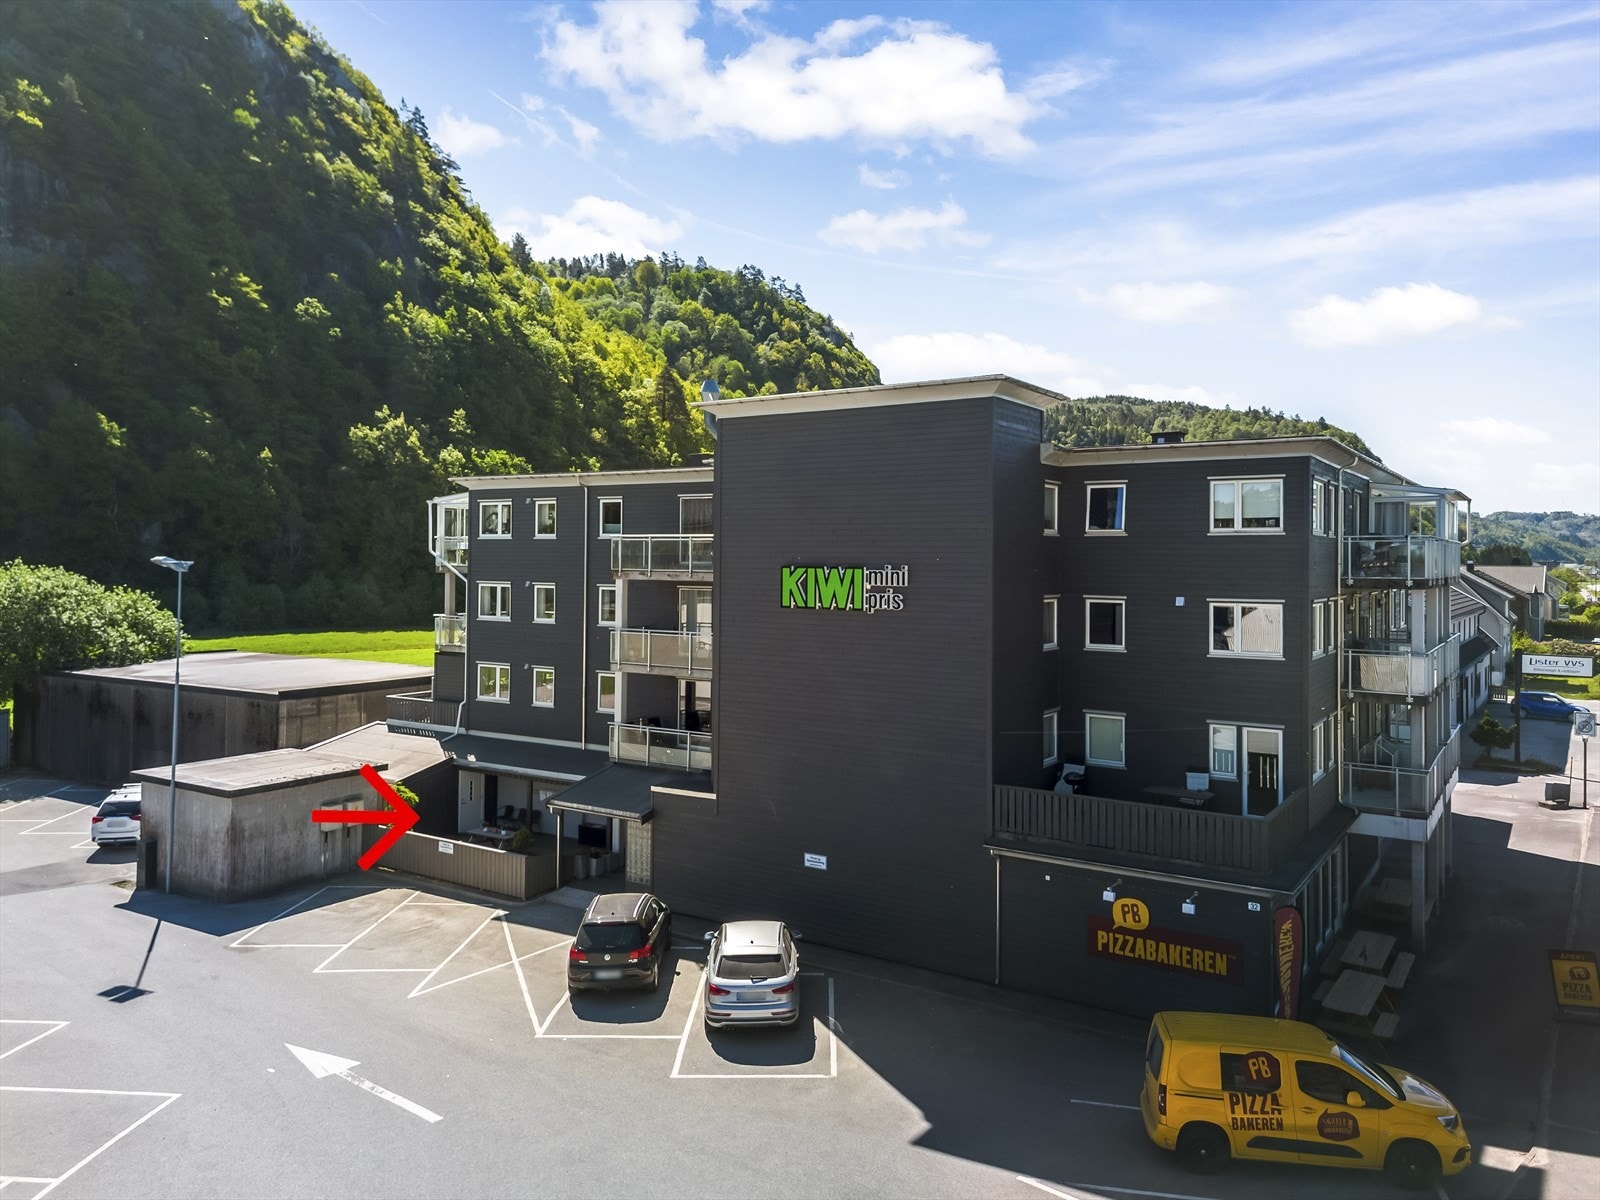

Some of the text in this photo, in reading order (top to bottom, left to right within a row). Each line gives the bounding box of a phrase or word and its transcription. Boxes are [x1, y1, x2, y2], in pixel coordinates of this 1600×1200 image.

[867, 565, 908, 587] mini
[781, 566, 863, 611] KIWI
[867, 588, 904, 614] pris
[1529, 657, 1559, 666] Lister
[1121, 903, 1141, 924] PB
[1097, 930, 1228, 976] PIZZABAKEREN
[1562, 982, 1593, 995] PIZZA
[1247, 1057, 1272, 1080] PB
[1229, 1092, 1283, 1115] PIZZA
[1231, 1116, 1284, 1132] BAKEREN
